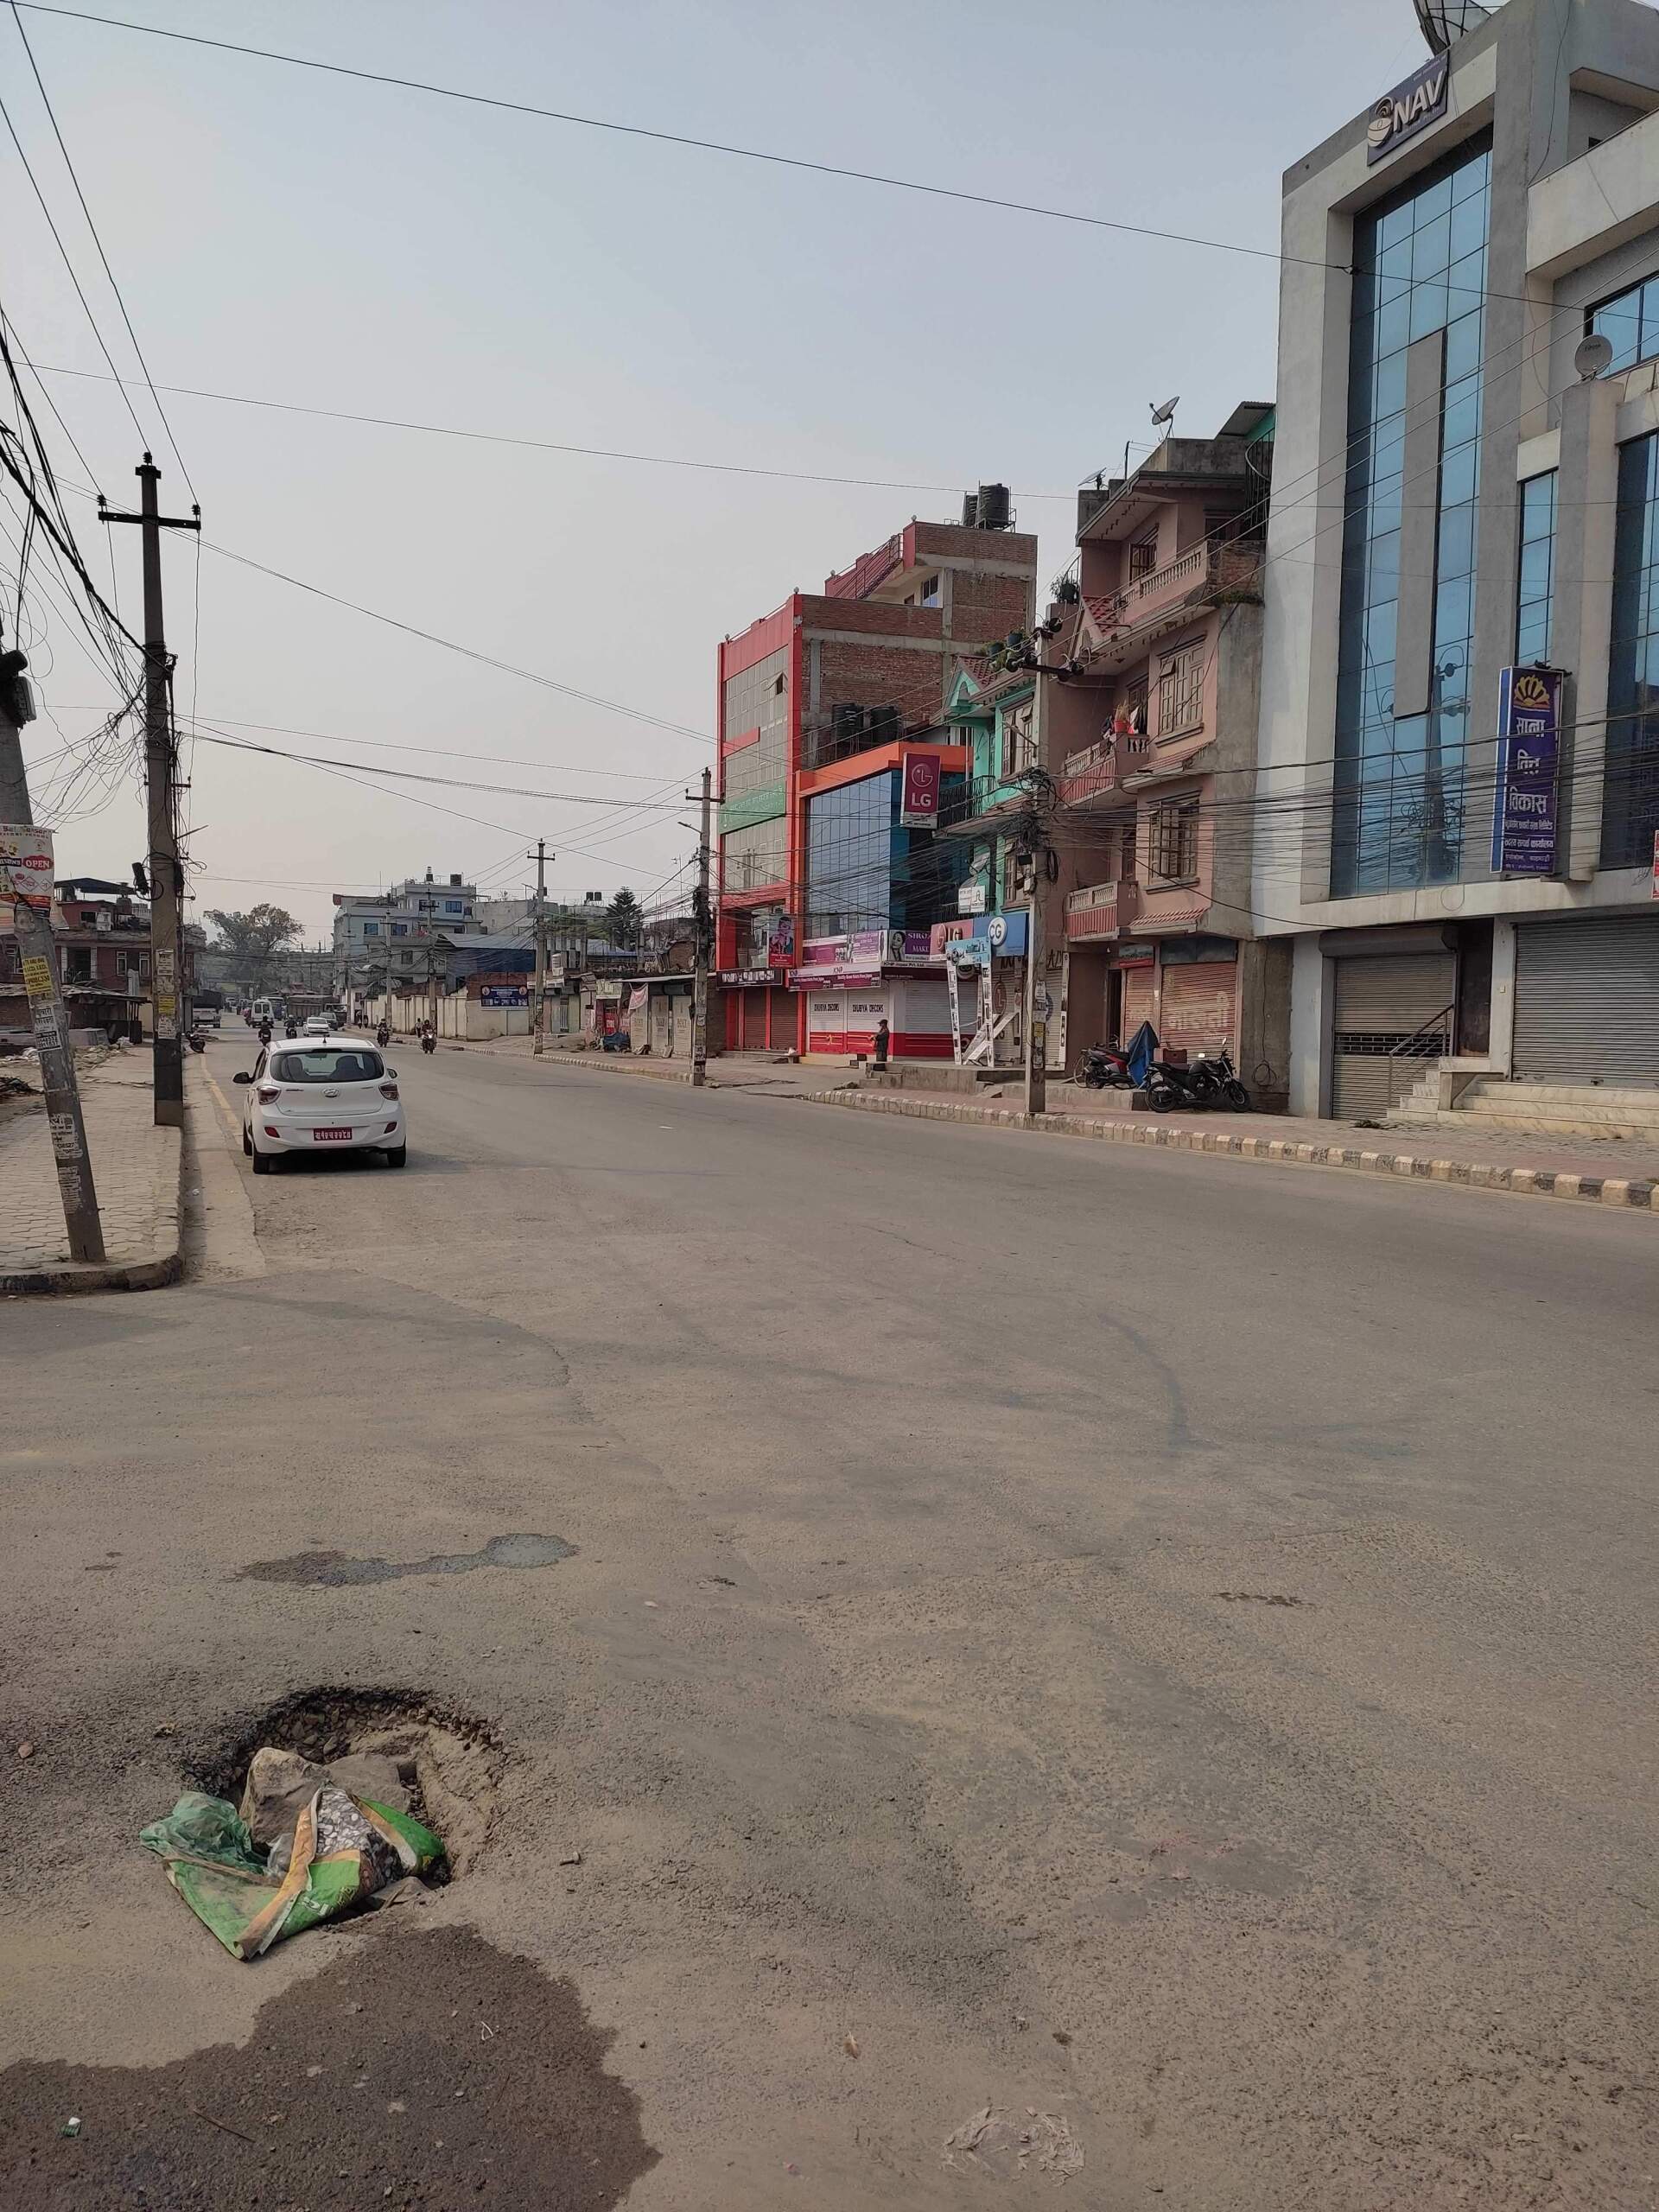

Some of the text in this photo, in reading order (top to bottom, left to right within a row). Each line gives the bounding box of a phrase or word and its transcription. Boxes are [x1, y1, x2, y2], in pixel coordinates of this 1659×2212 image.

[1393, 71, 1444, 132] NAV
[912, 792, 931, 807] LG
[26, 860, 50, 868] OPEN
[989, 924, 1002, 939] CG
